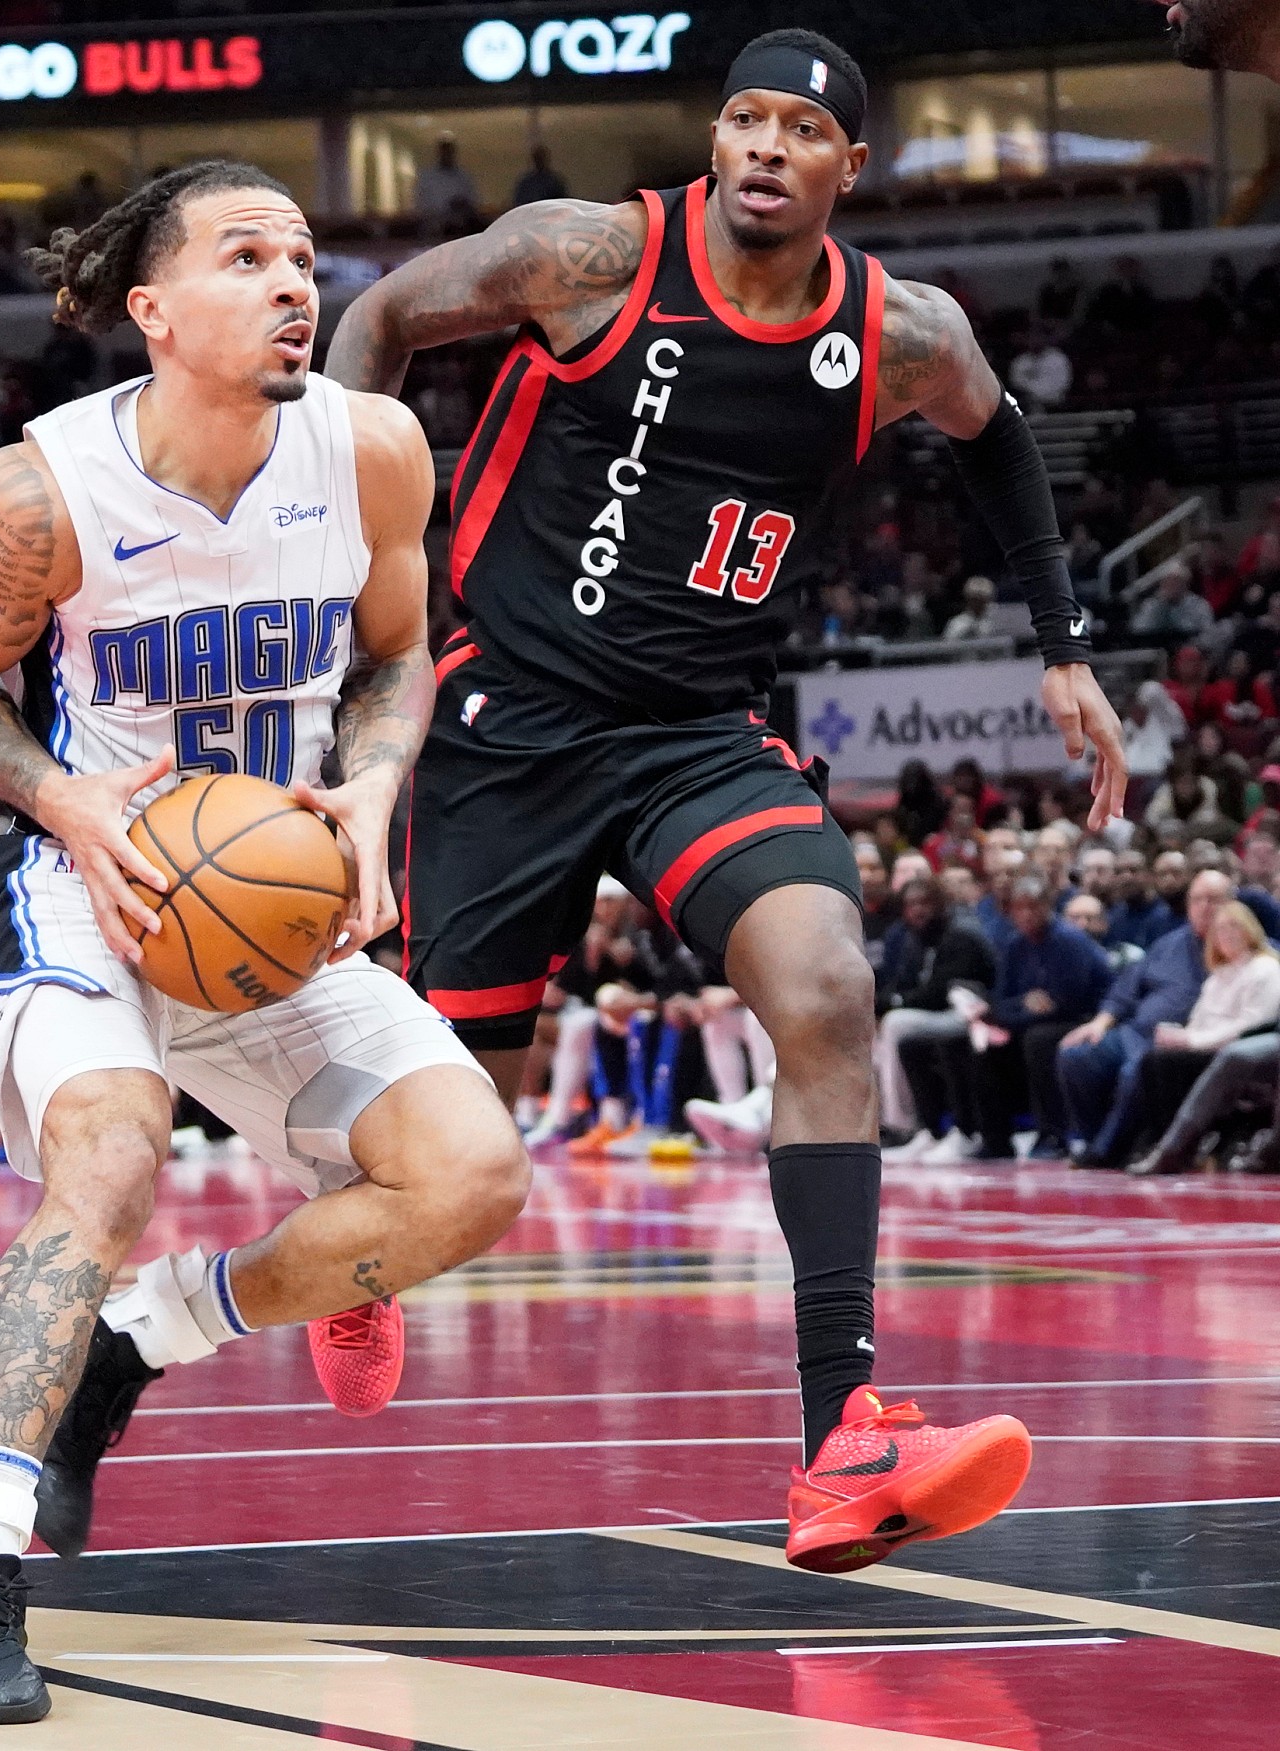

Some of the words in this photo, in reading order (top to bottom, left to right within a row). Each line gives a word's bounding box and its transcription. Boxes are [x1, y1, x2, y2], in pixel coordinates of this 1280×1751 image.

[83, 36, 263, 96] BULLS
[529, 12, 691, 77] razr
[572, 338, 684, 616] CHICAGO
[687, 498, 795, 604] 13
[89, 597, 354, 706] MAGIC
[174, 700, 294, 788] 50
